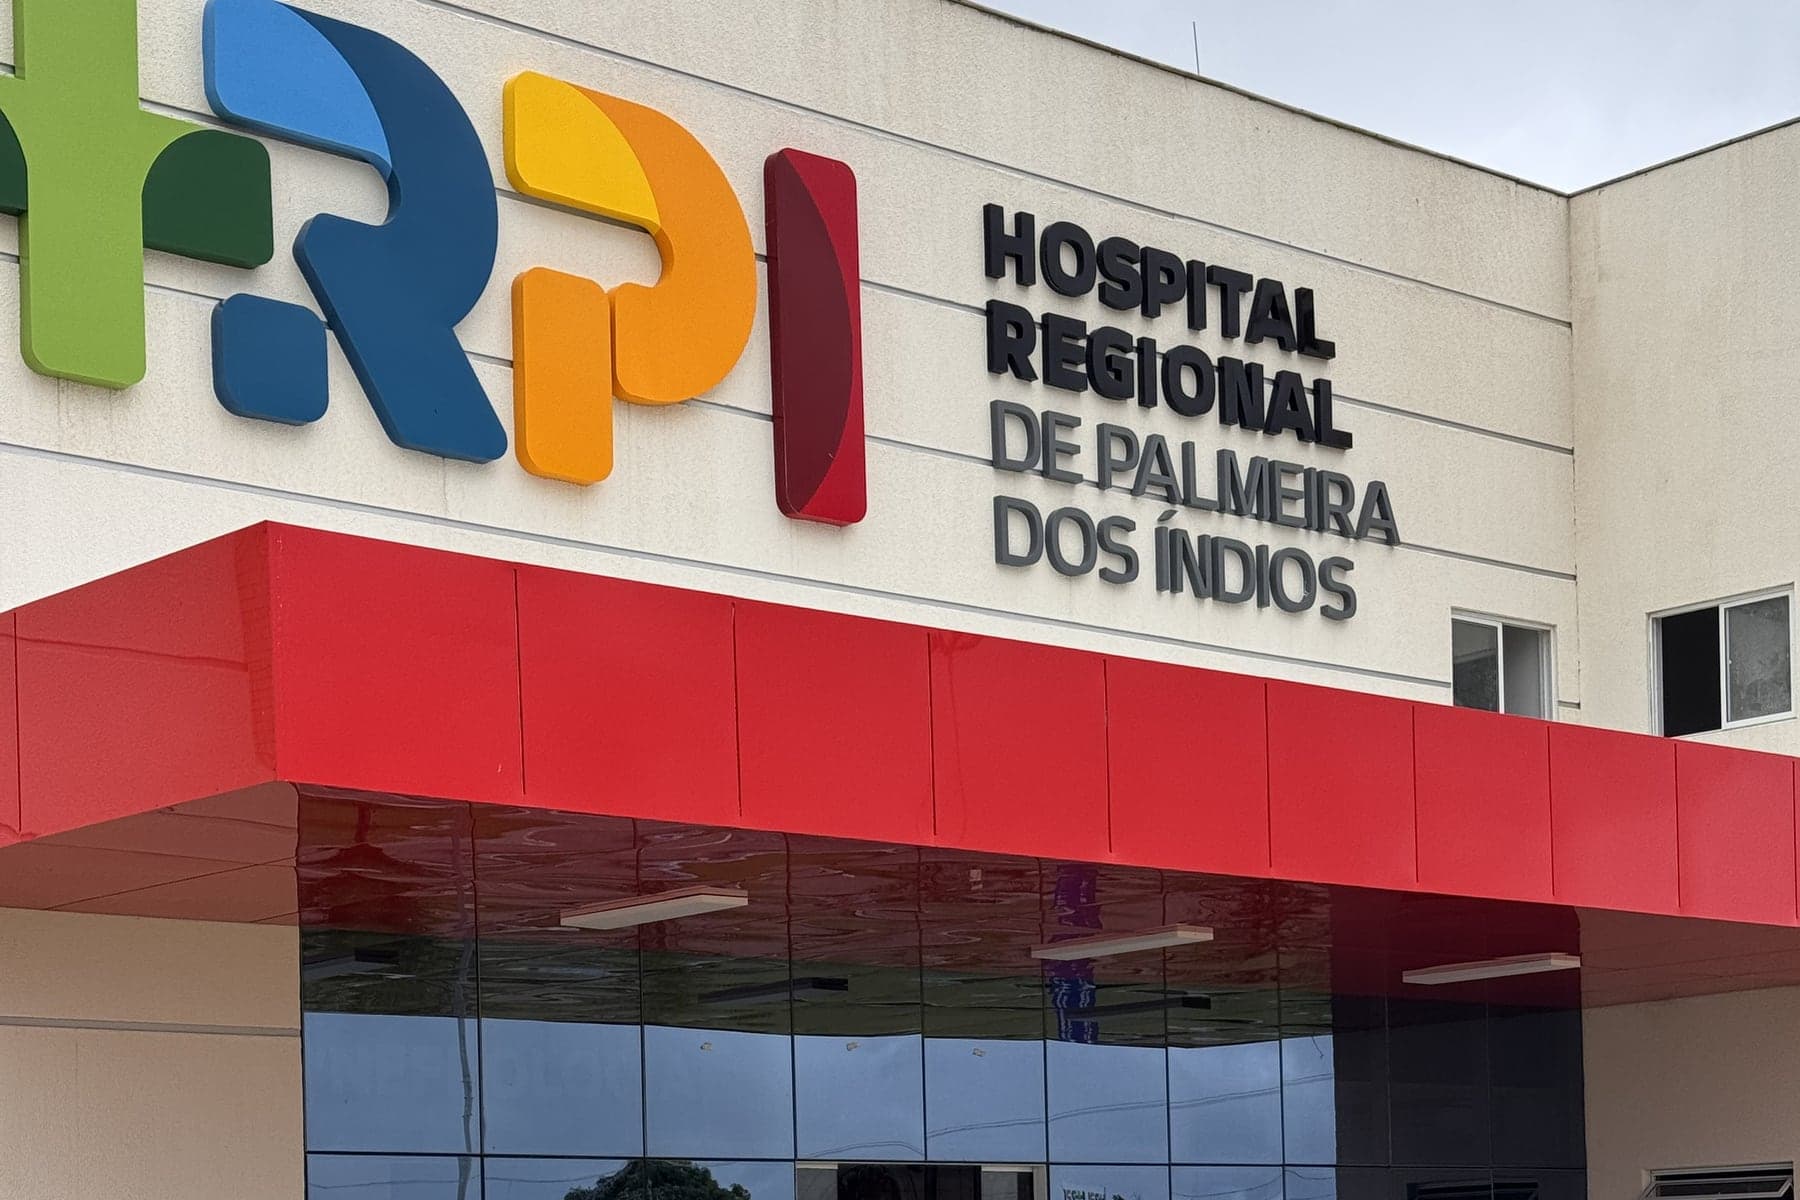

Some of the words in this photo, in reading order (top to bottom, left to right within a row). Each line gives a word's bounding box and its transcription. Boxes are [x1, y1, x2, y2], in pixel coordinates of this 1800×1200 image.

[983, 203, 1336, 360] HOSPITAL
[985, 299, 1353, 450] REGIONAL
[990, 399, 1084, 485] DE
[1096, 423, 1401, 546] PALMEIRA
[993, 495, 1139, 584] DOS
[1155, 509, 1358, 621] ÍNDIOS
